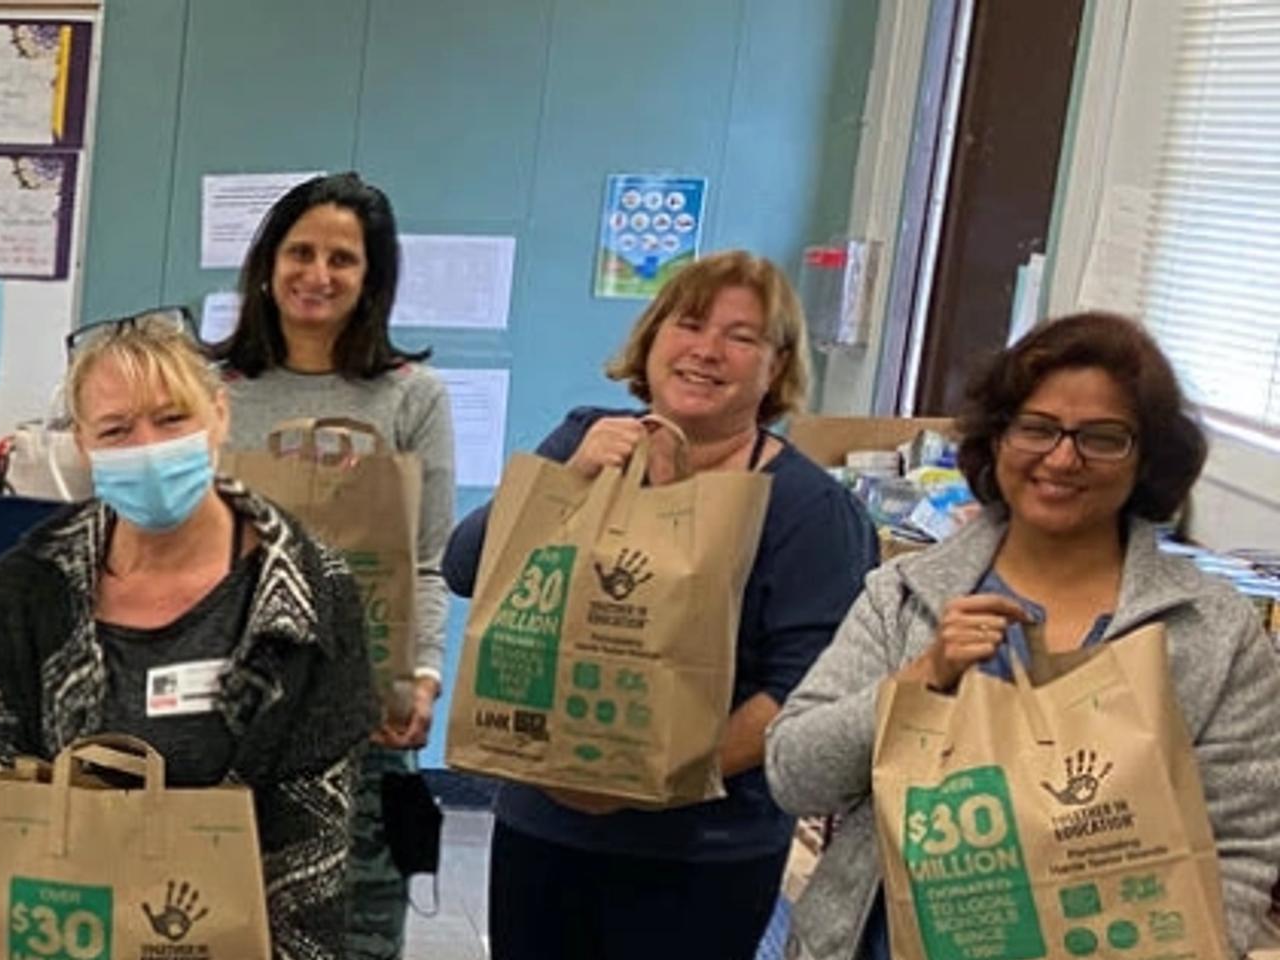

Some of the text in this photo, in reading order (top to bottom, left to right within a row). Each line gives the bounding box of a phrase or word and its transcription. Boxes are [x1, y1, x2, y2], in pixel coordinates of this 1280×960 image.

[512, 565, 564, 614] 30
[908, 793, 1008, 855] $30
[909, 847, 1020, 881] MILLION
